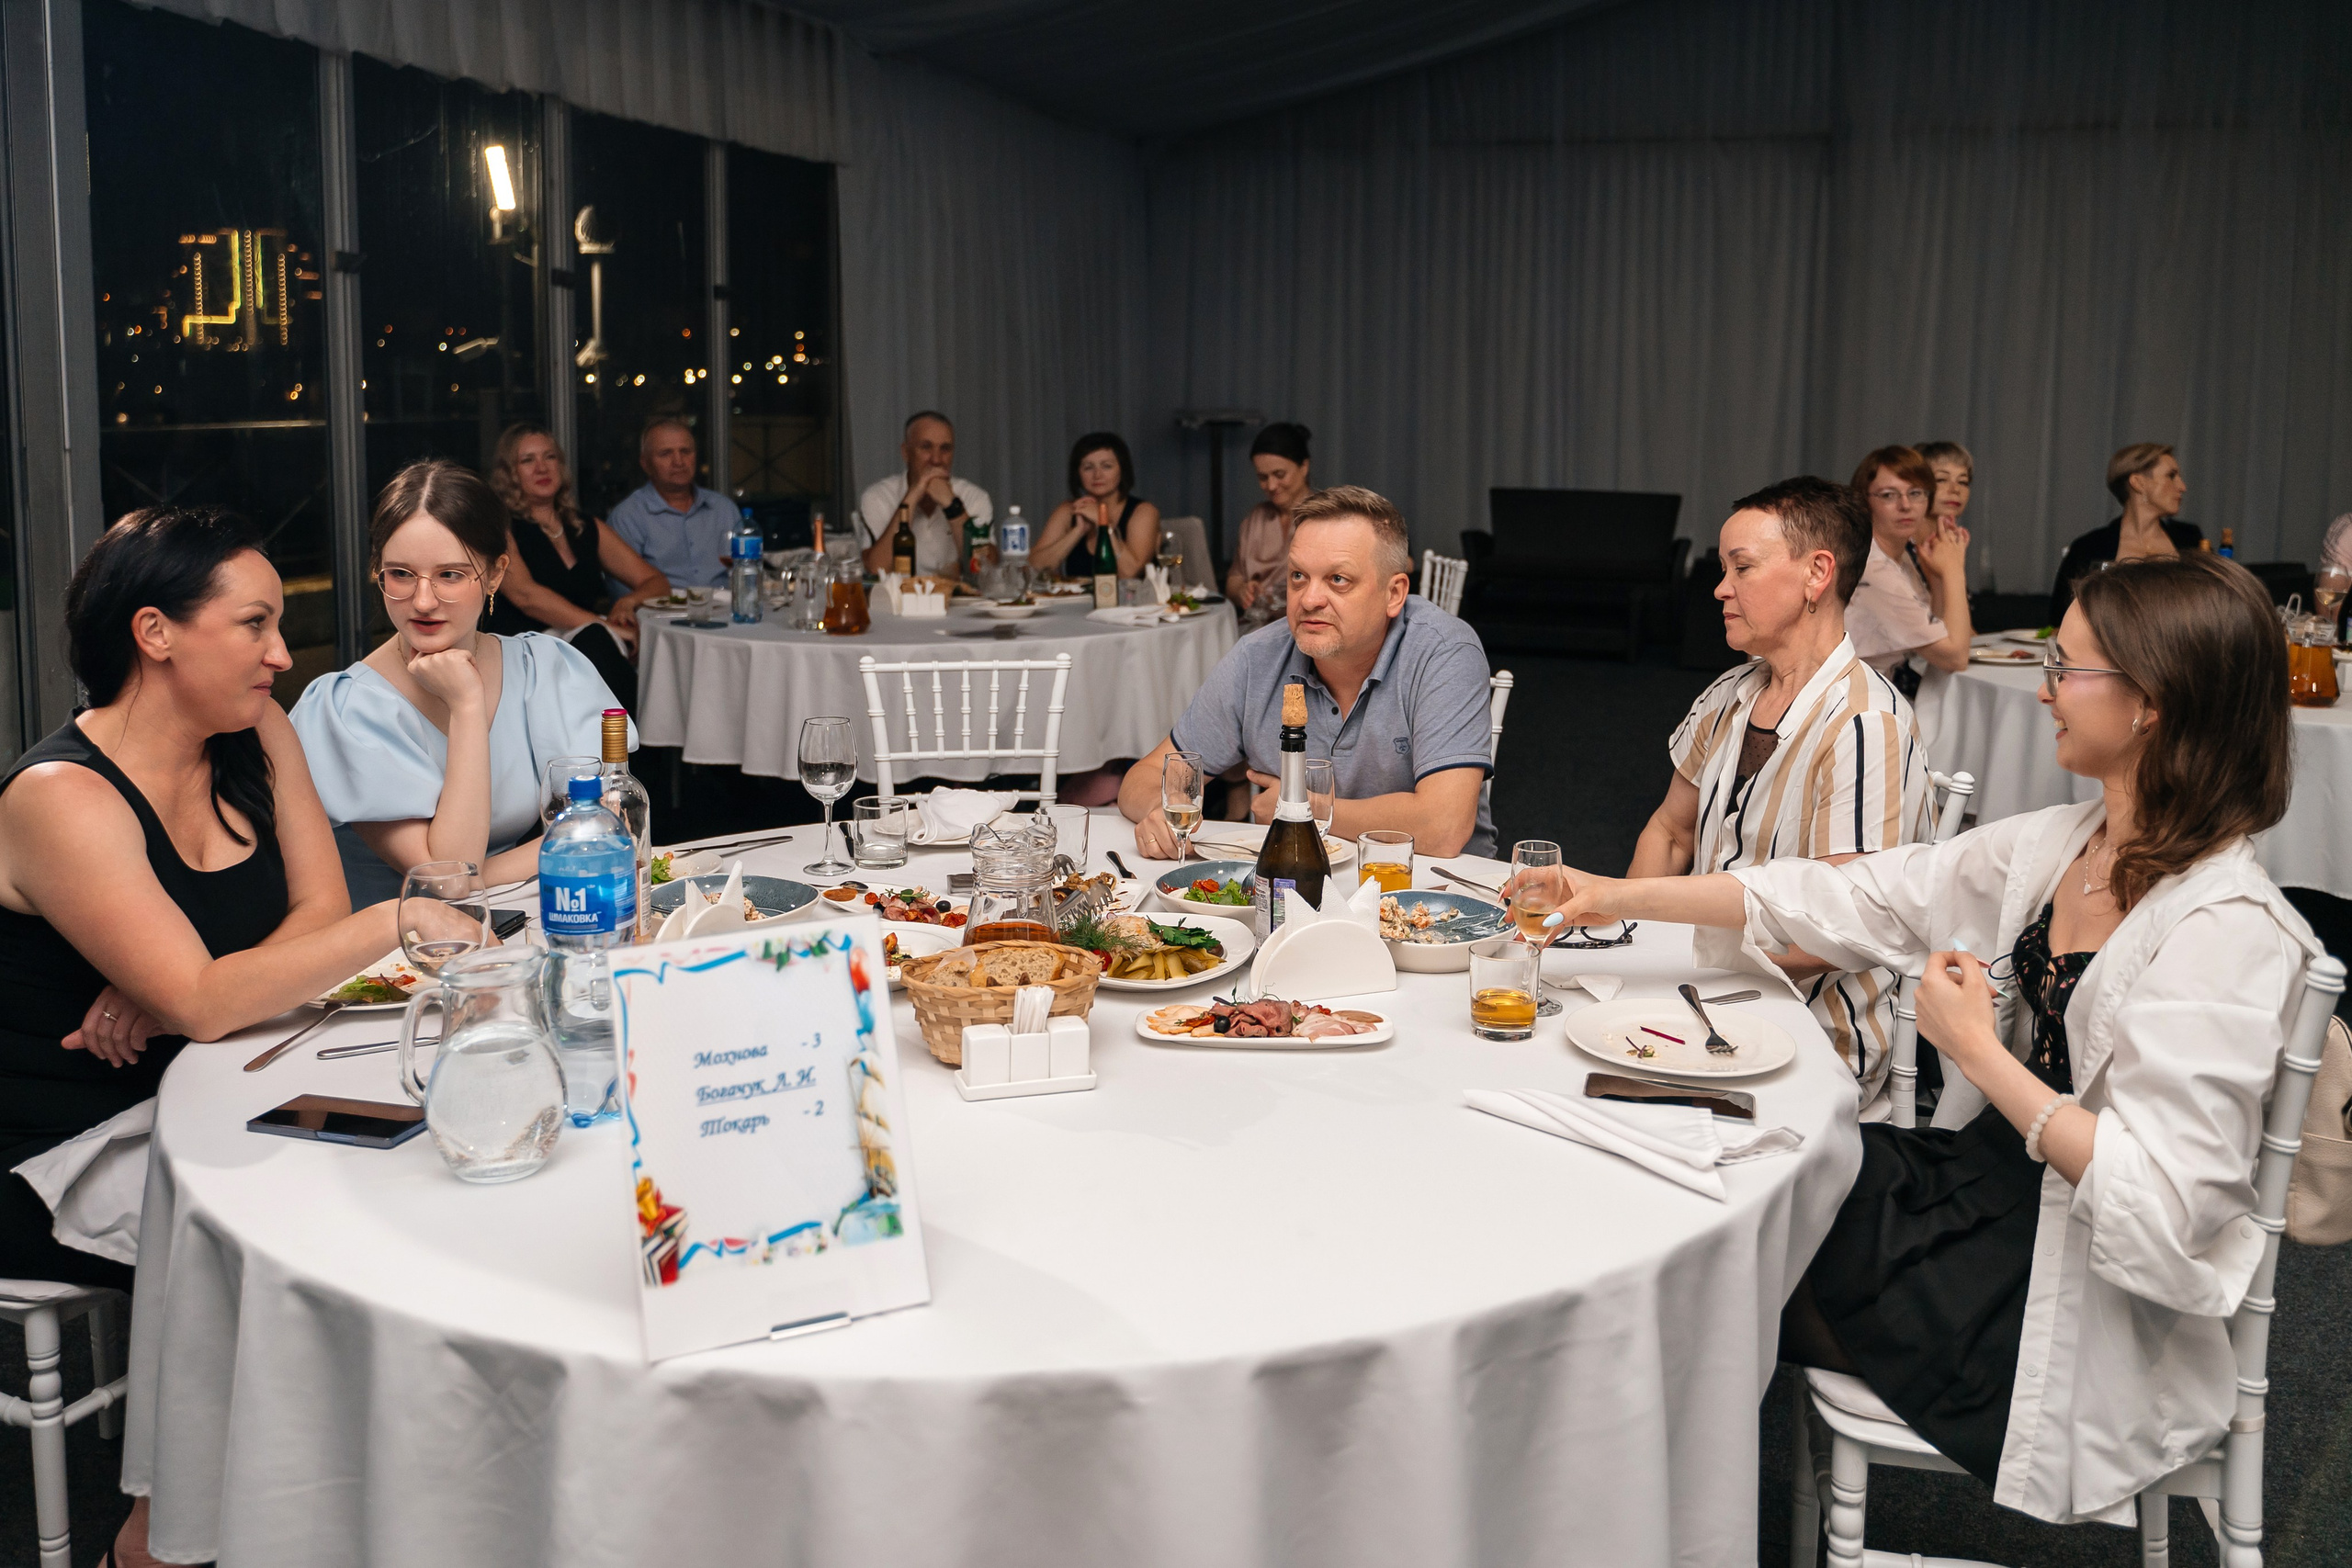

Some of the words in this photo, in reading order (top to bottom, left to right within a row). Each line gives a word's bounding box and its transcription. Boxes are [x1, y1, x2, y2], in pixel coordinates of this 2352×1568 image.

[555, 886, 587, 912] №1
[548, 912, 599, 924] ШМАКОВКА
[694, 1044, 768, 1068] Мохнова
[695, 1077, 774, 1100] Богачук
[699, 1114, 770, 1138] Токарь
